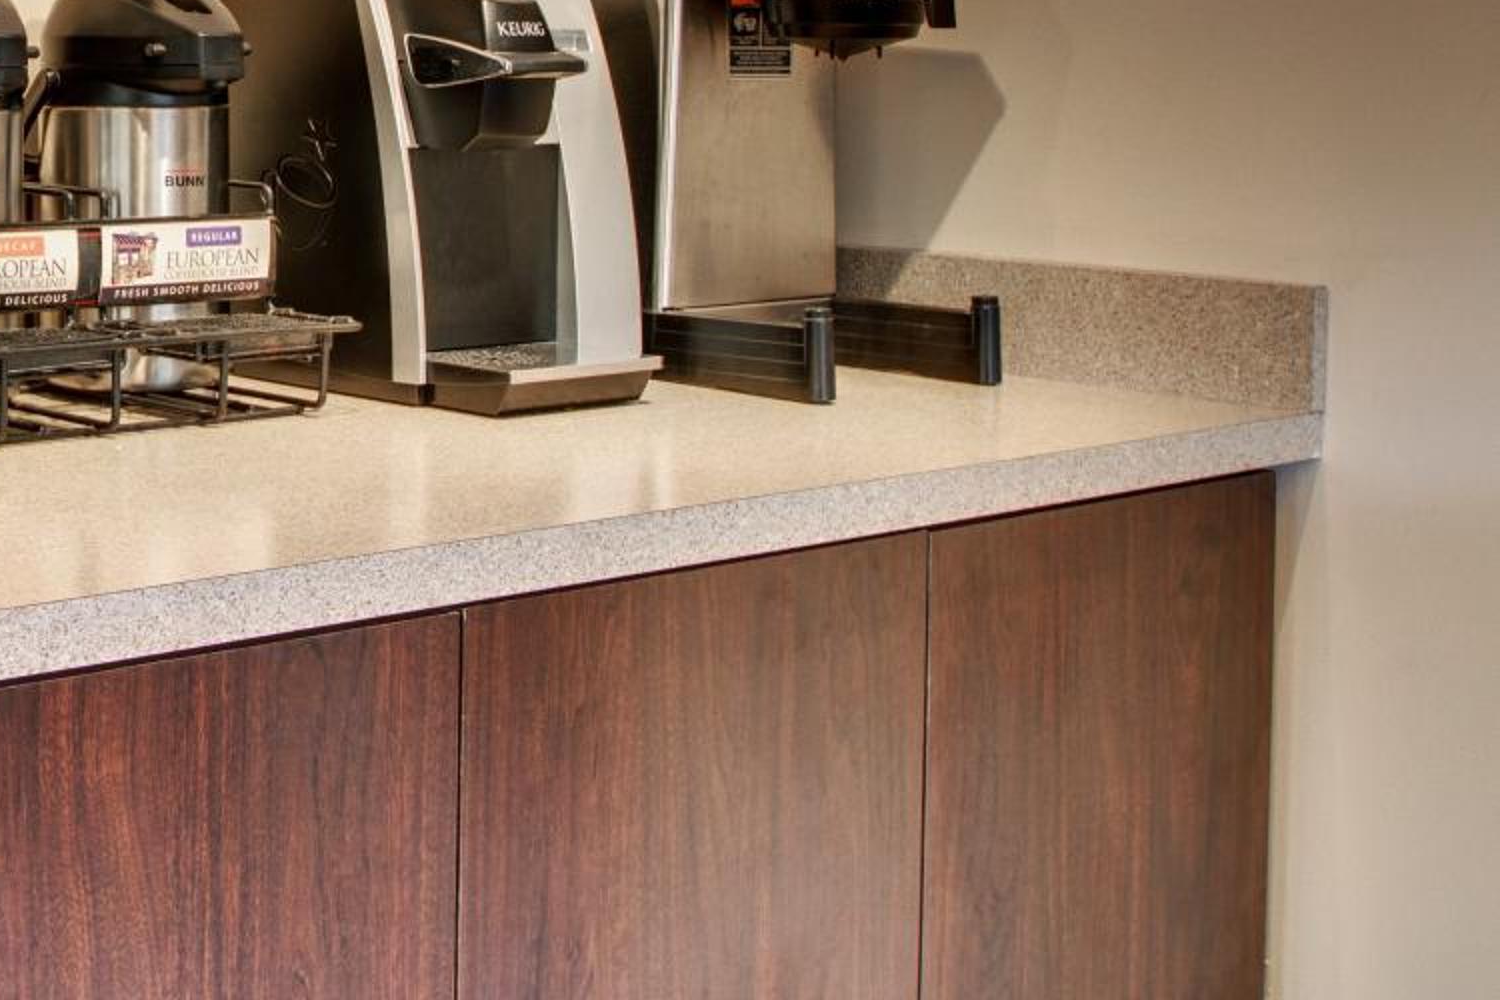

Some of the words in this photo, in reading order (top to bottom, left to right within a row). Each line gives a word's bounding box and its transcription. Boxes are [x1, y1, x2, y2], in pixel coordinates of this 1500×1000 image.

[496, 21, 546, 37] KEURIG
[165, 175, 205, 187] BUNN
[190, 230, 239, 243] REGULAR
[167, 247, 260, 270] EUROPEAN
[114, 287, 149, 298] FRESH
[153, 284, 199, 296] SMOOTH
[203, 281, 260, 293] DELICIOUS
[4, 293, 68, 306] DELICIOUS
